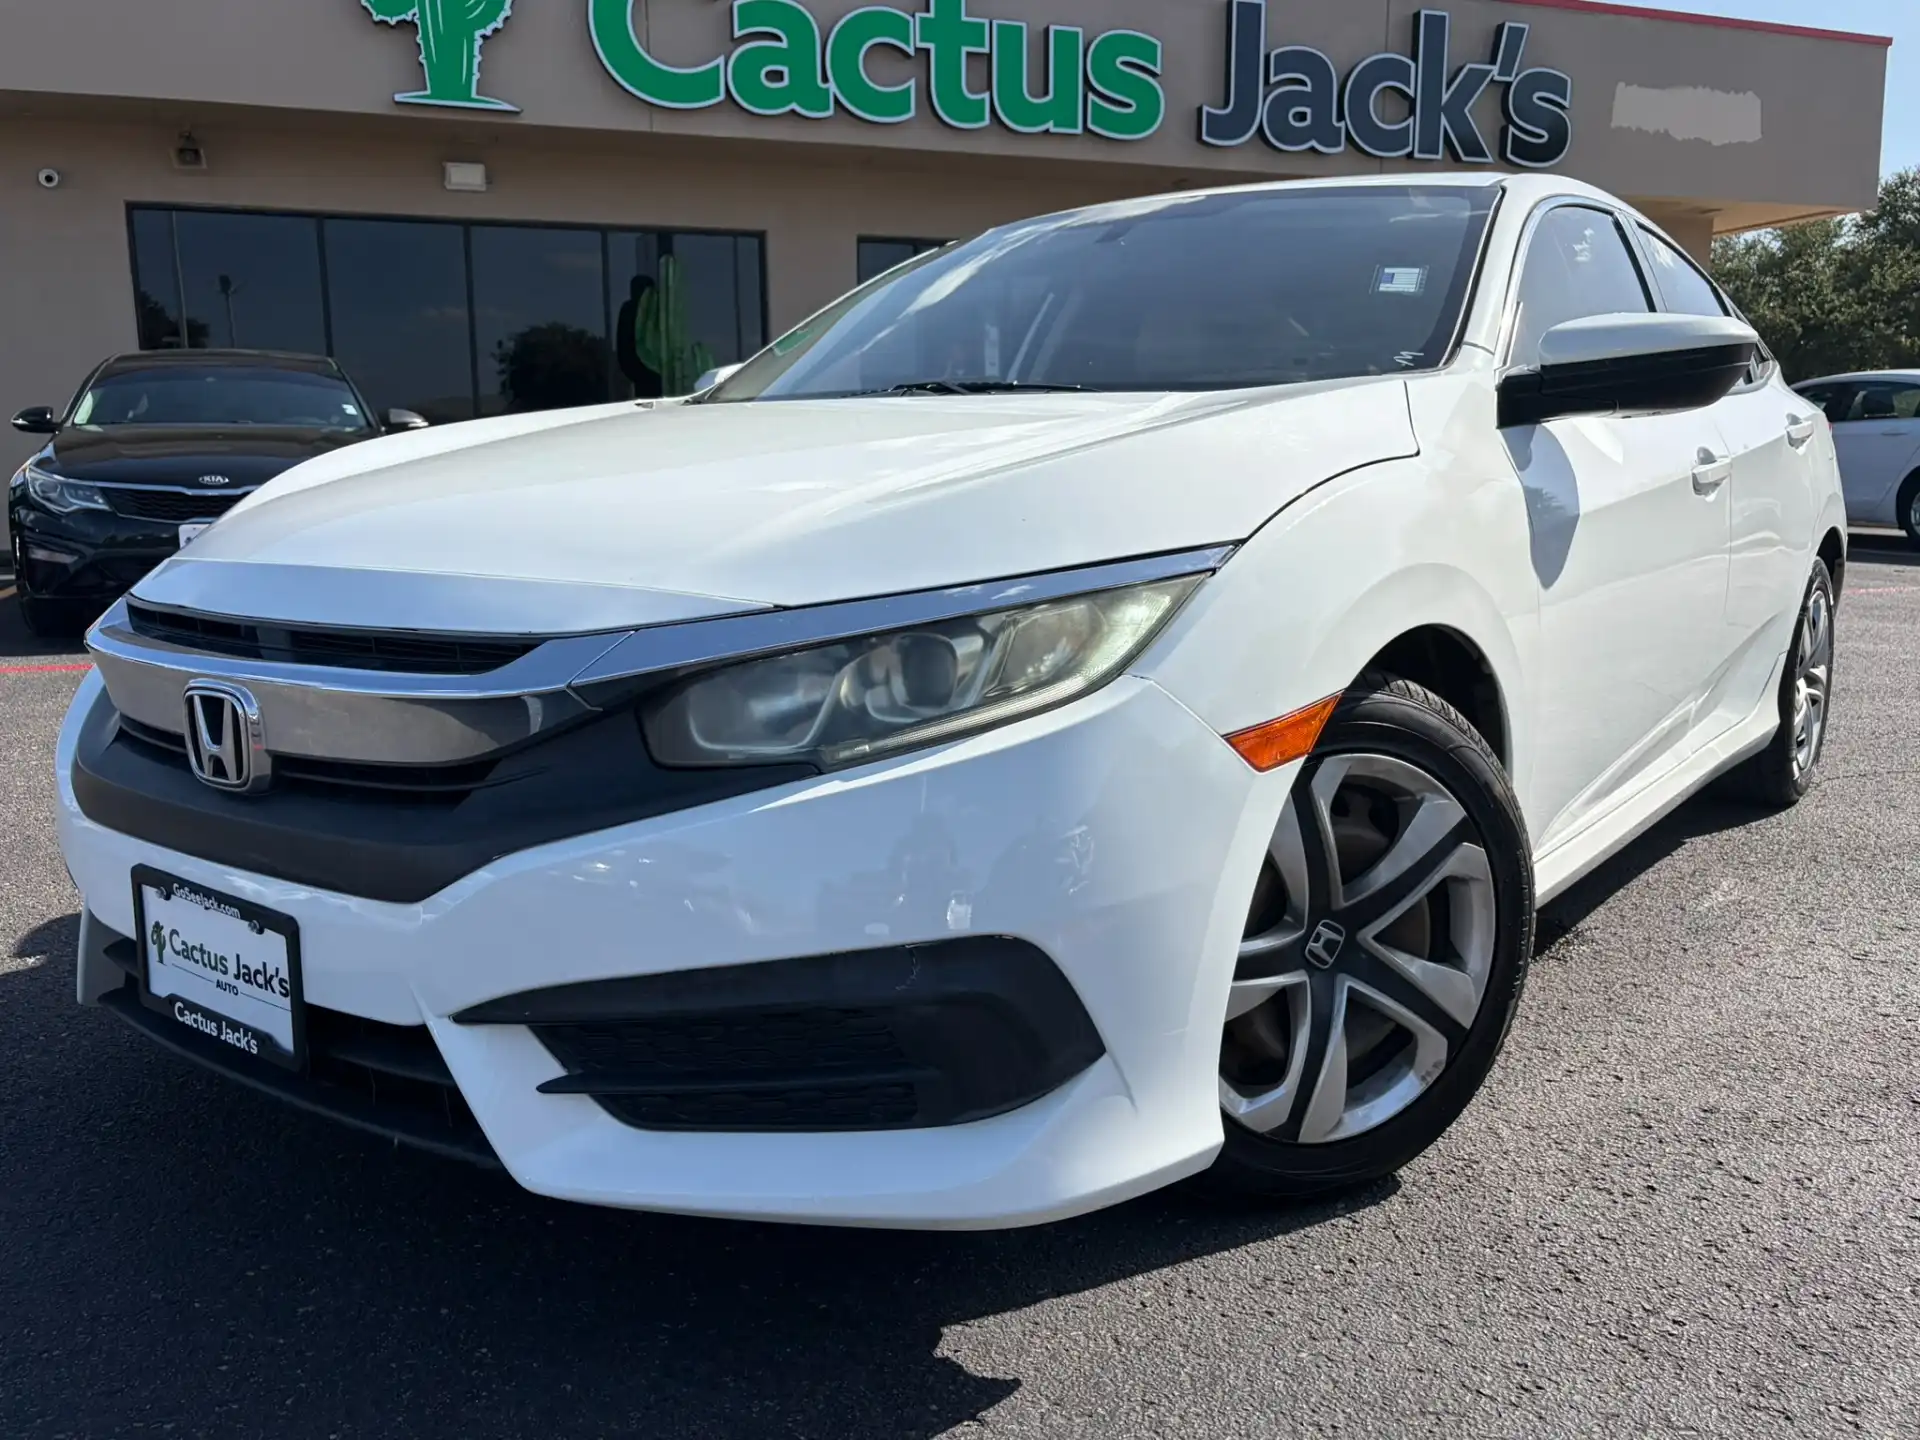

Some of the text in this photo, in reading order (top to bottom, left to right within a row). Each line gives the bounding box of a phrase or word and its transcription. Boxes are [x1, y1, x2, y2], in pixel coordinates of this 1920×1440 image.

[587, 0, 1572, 168] Cactus Jack's
[202, 474, 225, 484] KIA
[169, 928, 290, 998] Cactus Jack's
[215, 979, 239, 996] AUTO
[174, 1001, 258, 1055] Cactus Jack's
